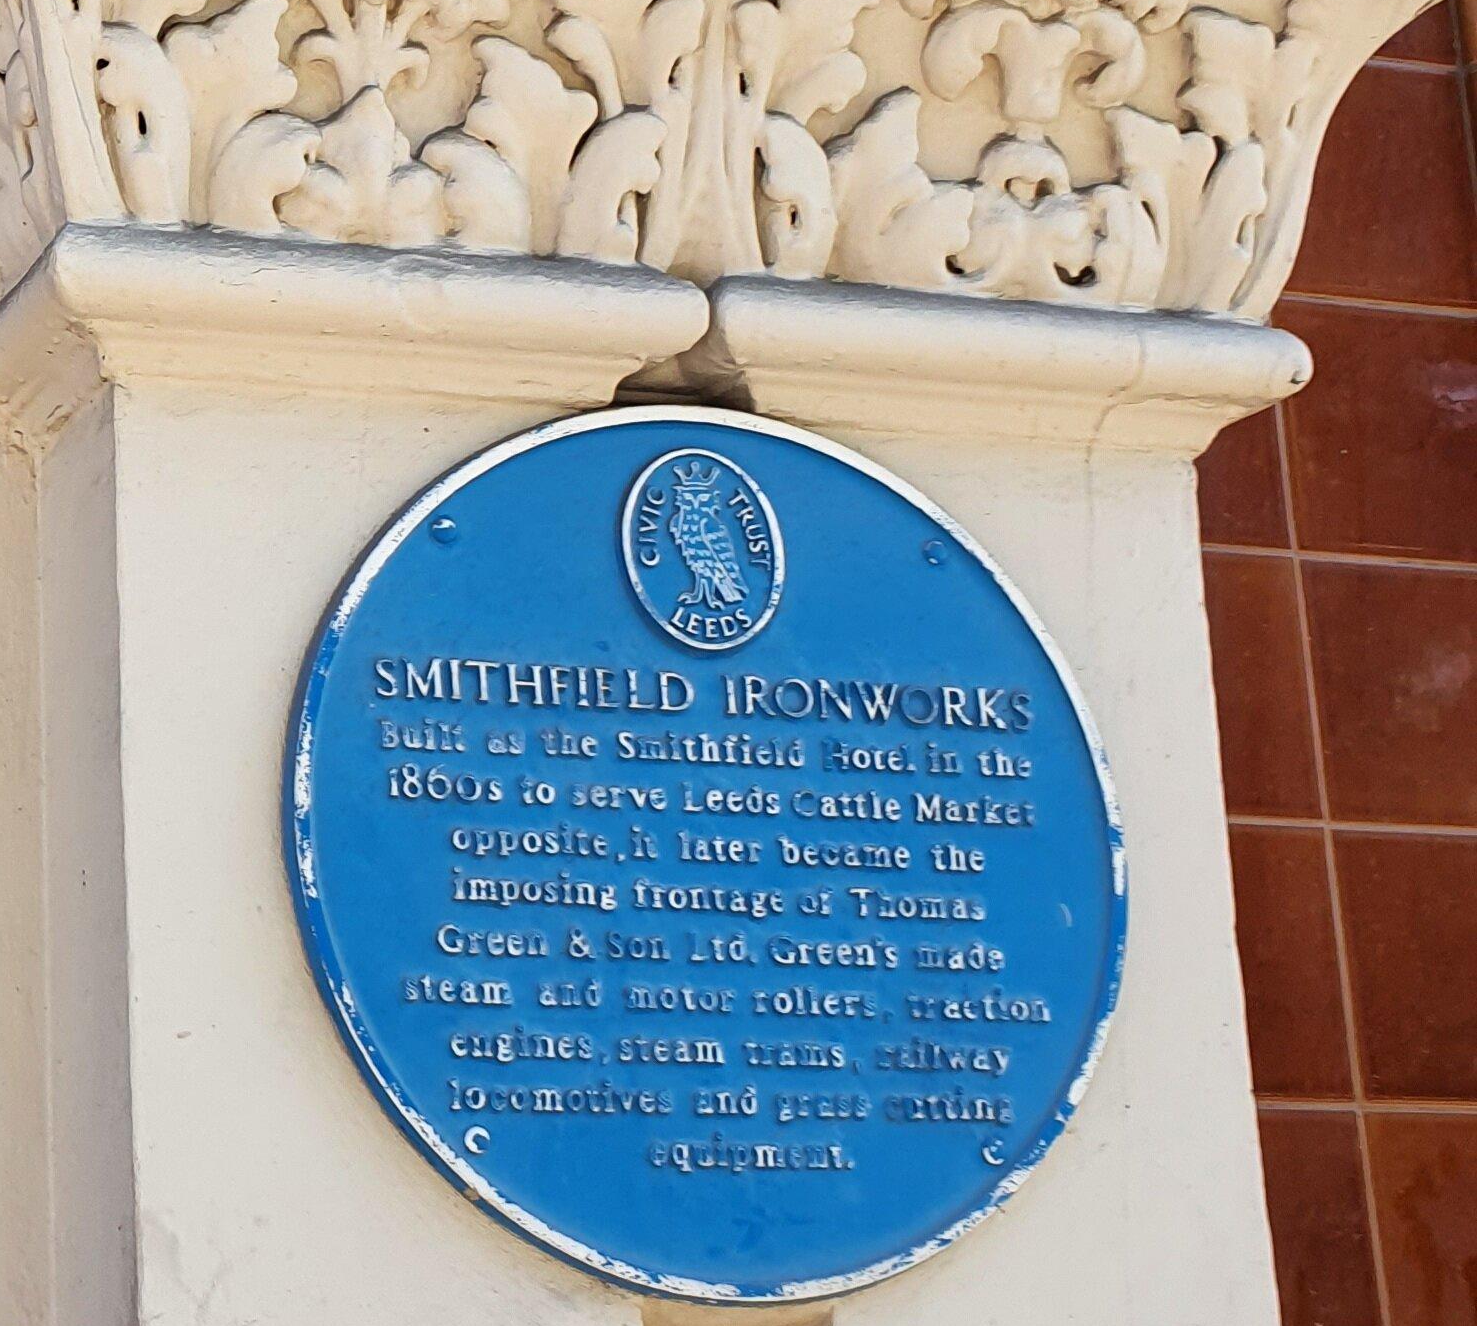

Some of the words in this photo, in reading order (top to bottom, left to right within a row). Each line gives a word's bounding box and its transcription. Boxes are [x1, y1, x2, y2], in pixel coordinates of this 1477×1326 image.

[638, 486, 667, 566] CIVIC
[727, 487, 772, 571] TRUST
[670, 606, 753, 639] LEEDS
[375, 657, 696, 712] SMITHFIELD
[723, 673, 1035, 731] IRONWORKS
[380, 719, 466, 753] Built
[485, 730, 524, 755] as
[540, 728, 599, 758] the
[617, 730, 806, 768] Smithfield
[823, 736, 916, 772] Hotel
[927, 742, 963, 774] in
[977, 747, 1033, 778] the
[388, 763, 504, 801] 1860s
[520, 775, 557, 806] to
[572, 783, 669, 811] serve
[682, 781, 781, 815] Leeds
[792, 789, 902, 822] Cattle
[914, 791, 1036, 826] Market
[451, 822, 625, 862] opposite,
[630, 825, 660, 860] it
[677, 828, 763, 863] later
[777, 834, 912, 869] became
[931, 842, 986, 872] the
[451, 866, 620, 912] imposing
[633, 876, 785, 919] frontage
[798, 887, 835, 916] of
[849, 886, 988, 921] Thomas
[436, 923, 551, 958] Green
[567, 928, 597, 960] &
[606, 930, 672, 961] Son
[687, 929, 759, 964] Ltd.
[769, 934, 900, 970] Green's
[915, 940, 1006, 972] made
[404, 974, 514, 1006] steam
[538, 977, 604, 1009] and
[627, 981, 736, 1013] motor
[752, 985, 894, 1023] rollers,
[906, 985, 1053, 1023] traction
[449, 1025, 612, 1065] engines,
[619, 1033, 727, 1066] steam
[743, 1040, 864, 1073] trams,
[877, 1037, 1012, 1077] railway
[447, 1076, 674, 1115] locomotives
[693, 1084, 759, 1116] and
[776, 1092, 872, 1122] grass
[883, 1085, 1015, 1125] cutting
[648, 1131, 856, 1173] equipment.
